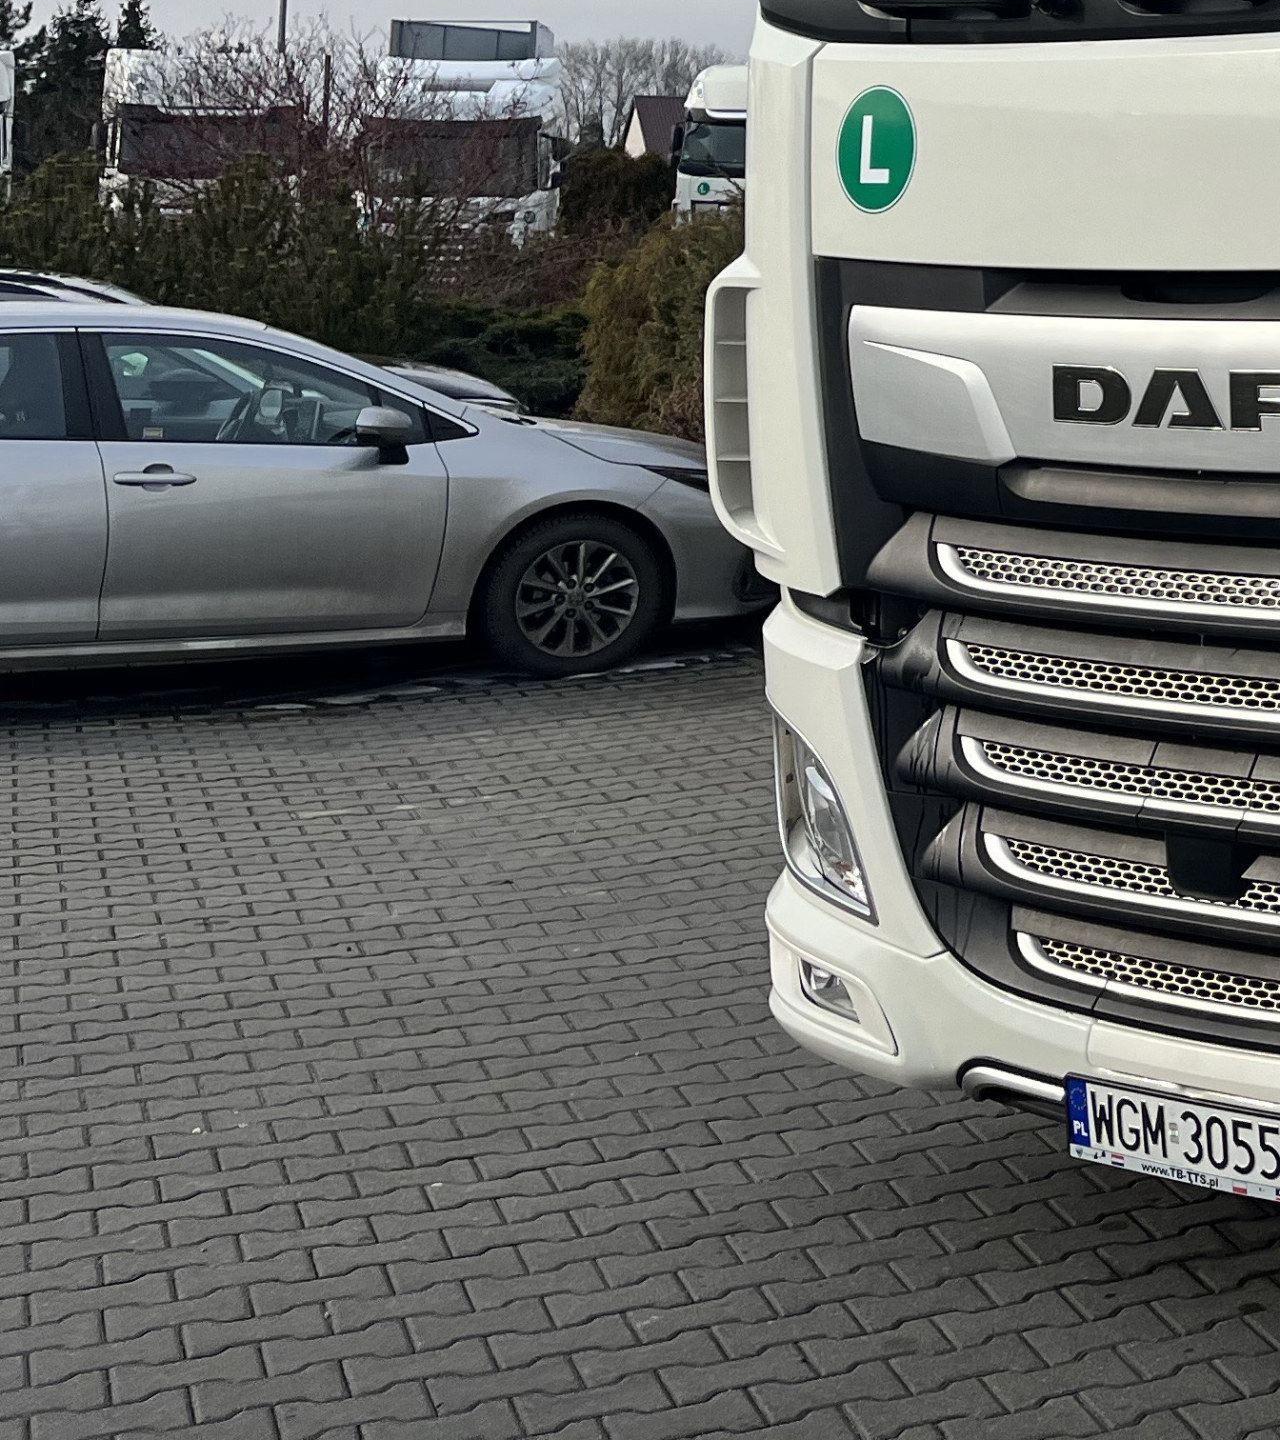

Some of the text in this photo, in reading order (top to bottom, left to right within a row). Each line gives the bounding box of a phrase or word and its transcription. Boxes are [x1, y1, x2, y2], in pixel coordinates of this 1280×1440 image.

[860, 114, 890, 184] L
[1072, 1119, 1089, 1138] PL
[1090, 1089, 1168, 1159] WGM
